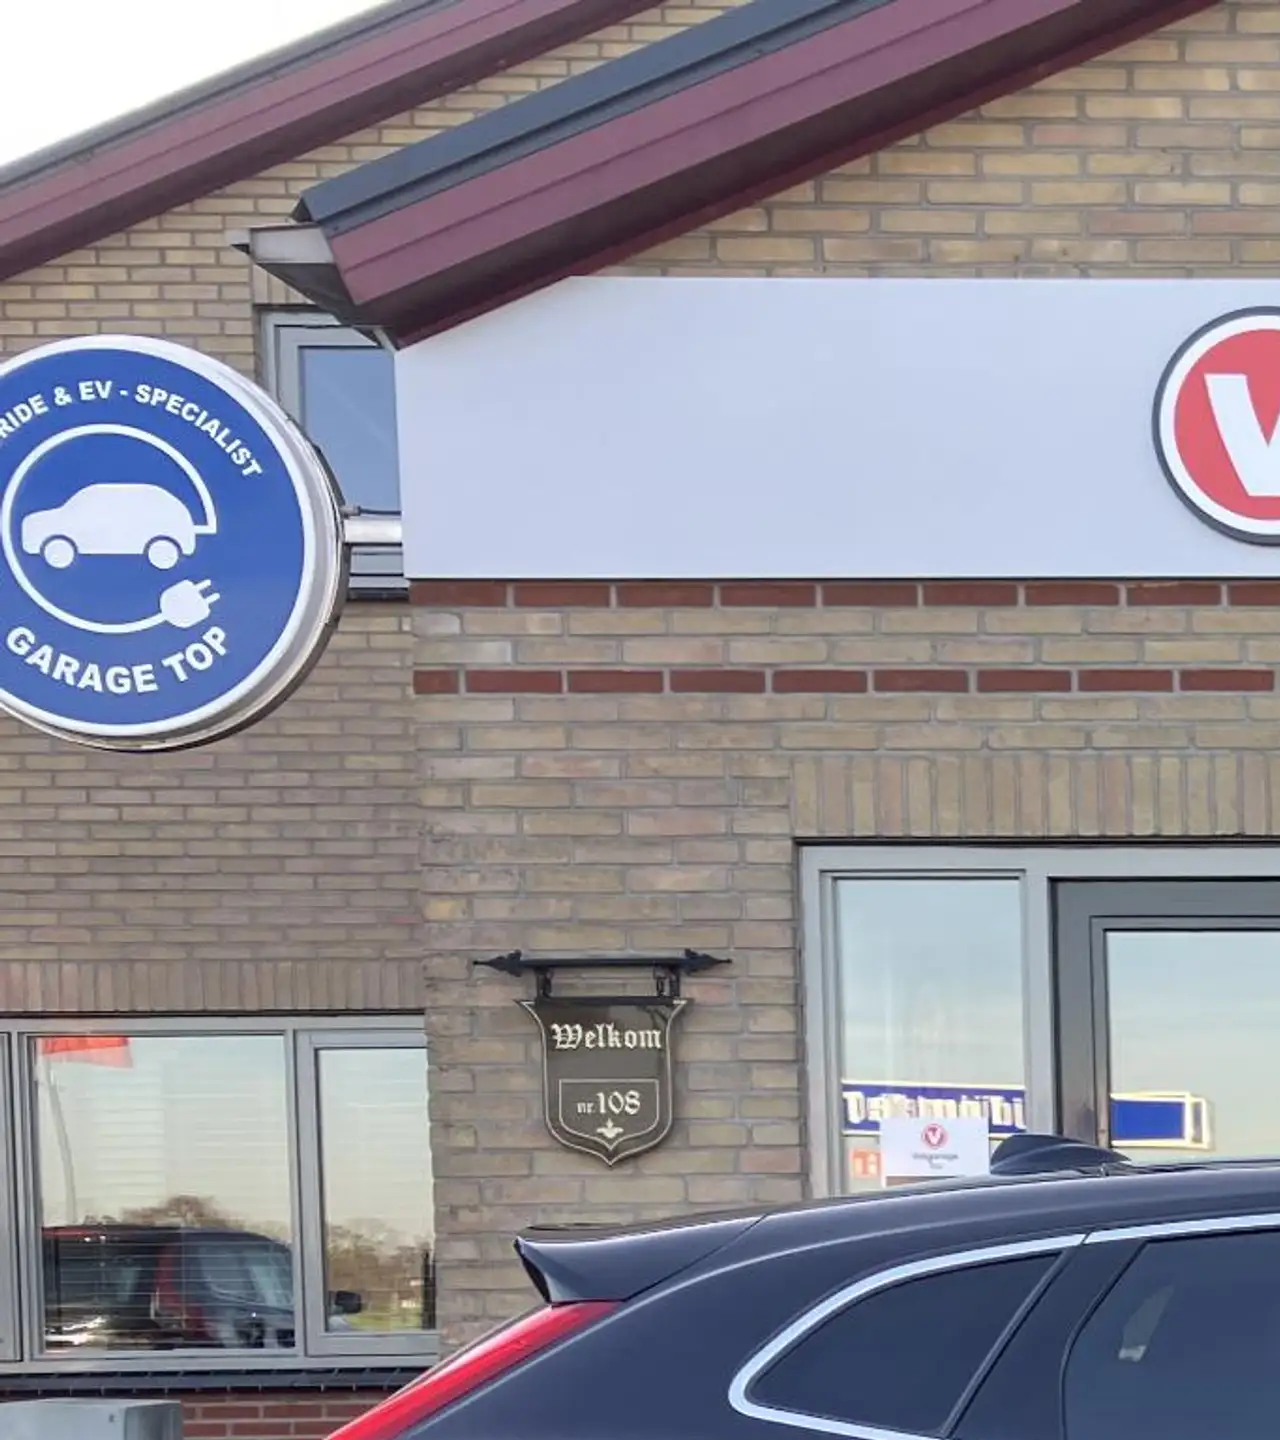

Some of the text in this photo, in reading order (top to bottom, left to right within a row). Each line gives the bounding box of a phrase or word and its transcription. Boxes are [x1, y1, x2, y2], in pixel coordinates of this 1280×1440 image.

[53, 386, 73, 406] &
[78, 379, 113, 401] EV
[135, 384, 263, 476] SPECIALIST
[6, 626, 227, 694] GARAGE TOP
[551, 1022, 663, 1050] Welkom
